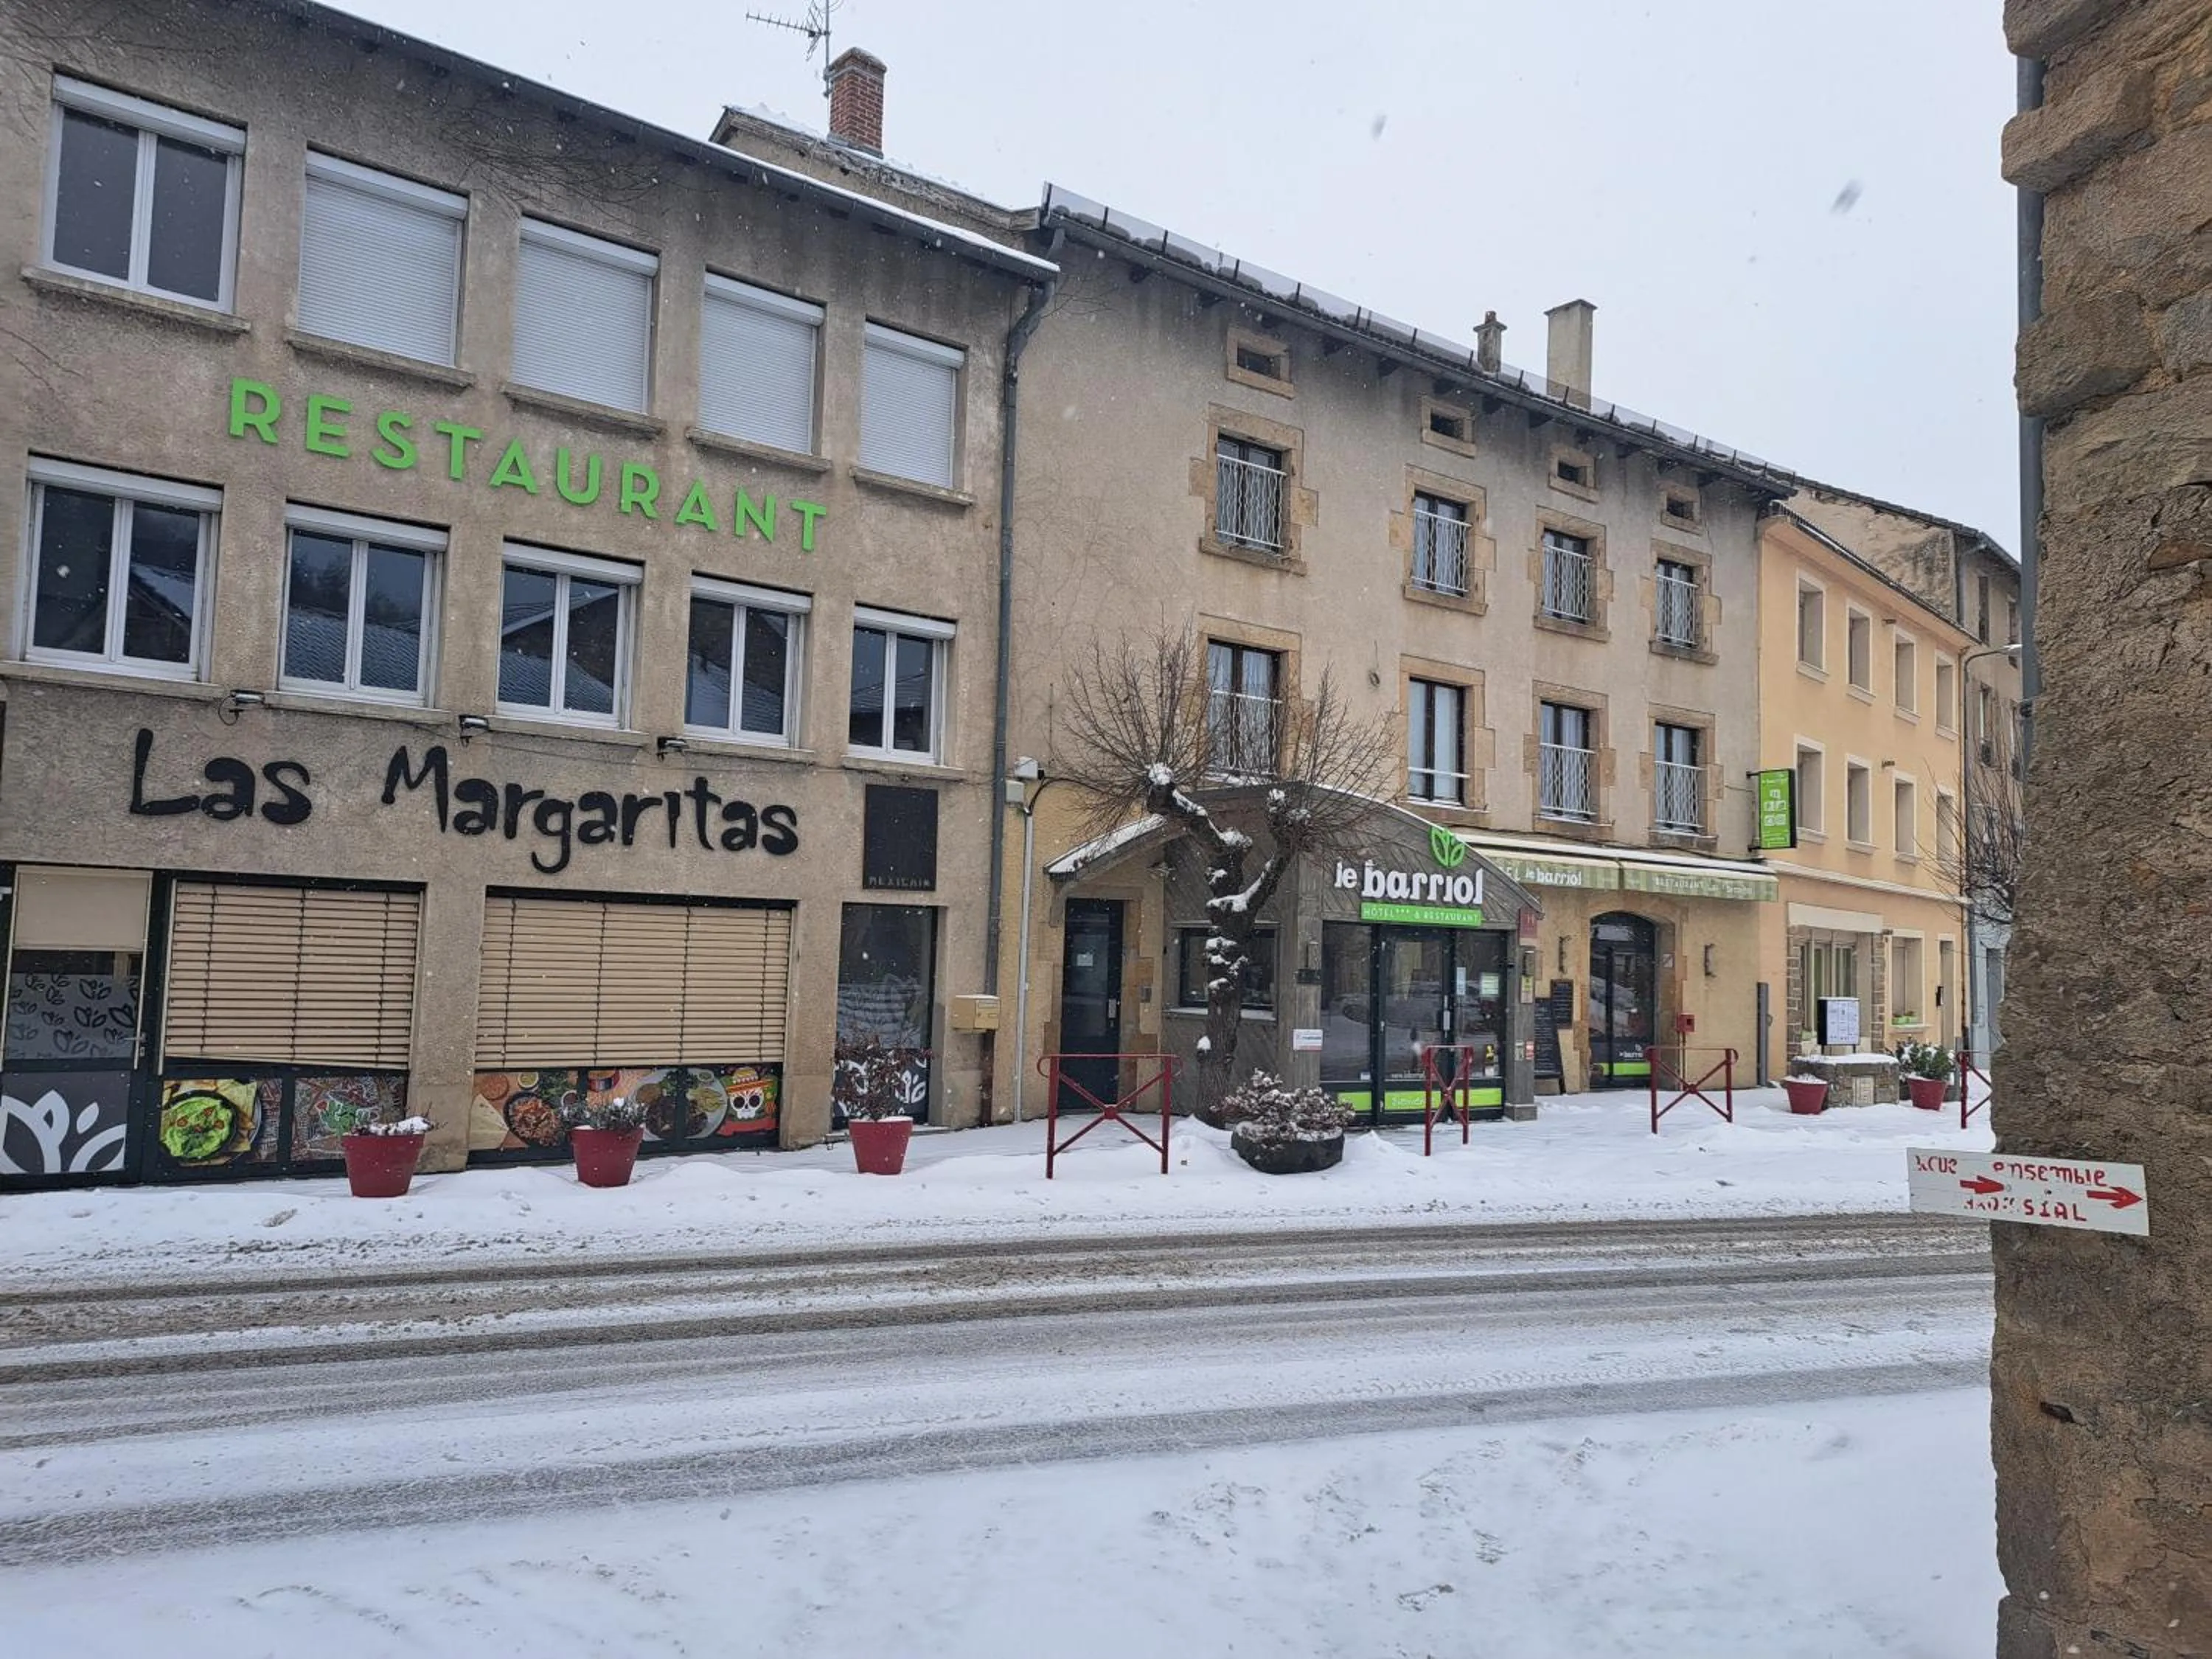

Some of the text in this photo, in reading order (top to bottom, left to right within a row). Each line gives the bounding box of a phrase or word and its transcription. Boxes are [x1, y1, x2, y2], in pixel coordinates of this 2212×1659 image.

[229, 378, 827, 552] RESTAURANT
[130, 728, 799, 874] Las Margaritas
[1334, 861, 1357, 888] le
[1362, 861, 1483, 905] barriol
[1537, 868, 1582, 886] barriol
[1424, 911, 1478, 923] RESTAURANT
